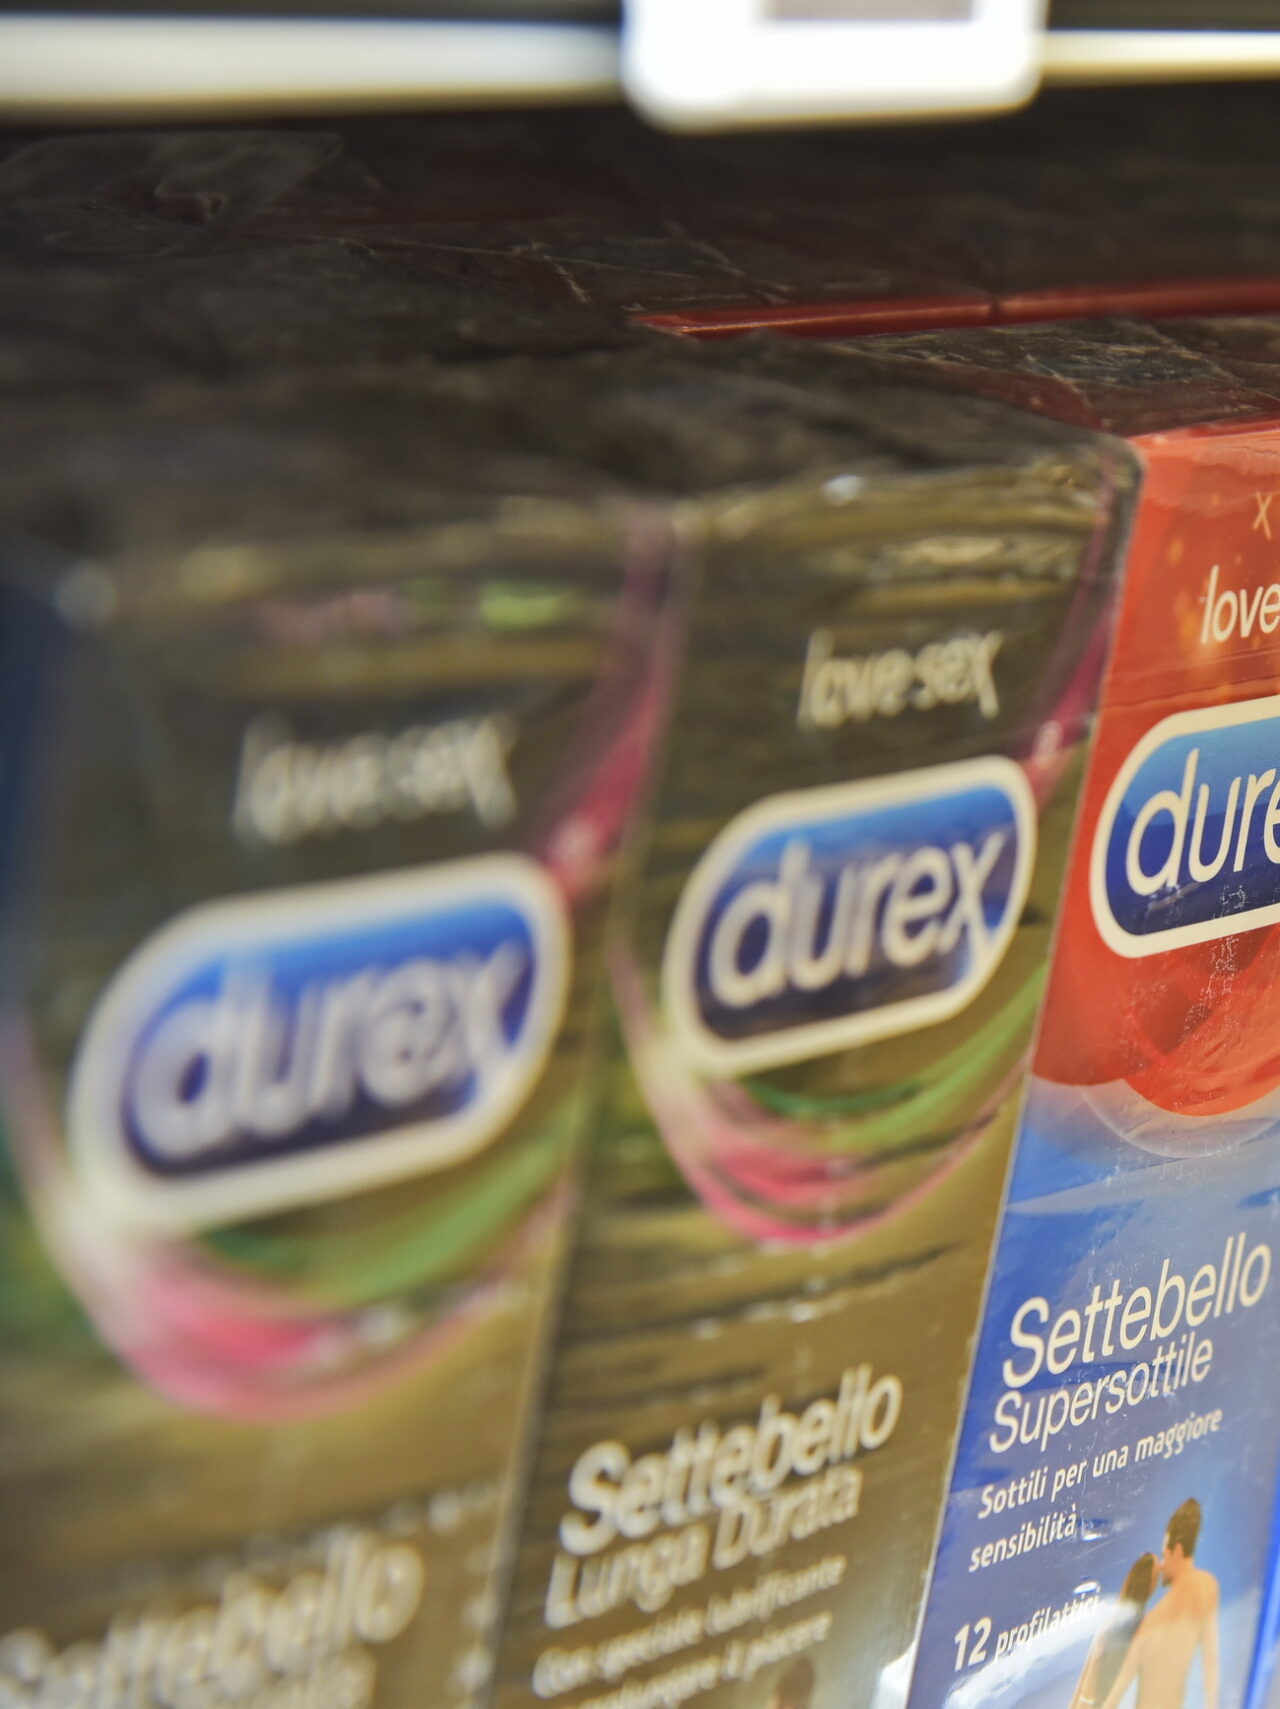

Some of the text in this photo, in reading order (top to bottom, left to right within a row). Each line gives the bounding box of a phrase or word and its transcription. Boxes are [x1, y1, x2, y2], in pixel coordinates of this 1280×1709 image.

[797, 627, 1003, 730] love sex
[706, 833, 1008, 1010] durex
[127, 935, 530, 1163] durex
[1000, 1231, 1273, 1389] Settebello
[560, 1362, 903, 1557] Settebello
[988, 1331, 1214, 1454] Supersottile
[976, 1408, 1224, 1521] Sottili per una maggiore
[543, 1464, 864, 1631] Lunga Durata
[968, 1504, 1078, 1574] sensibilità
[953, 1585, 1102, 1673] 12 profilattici
